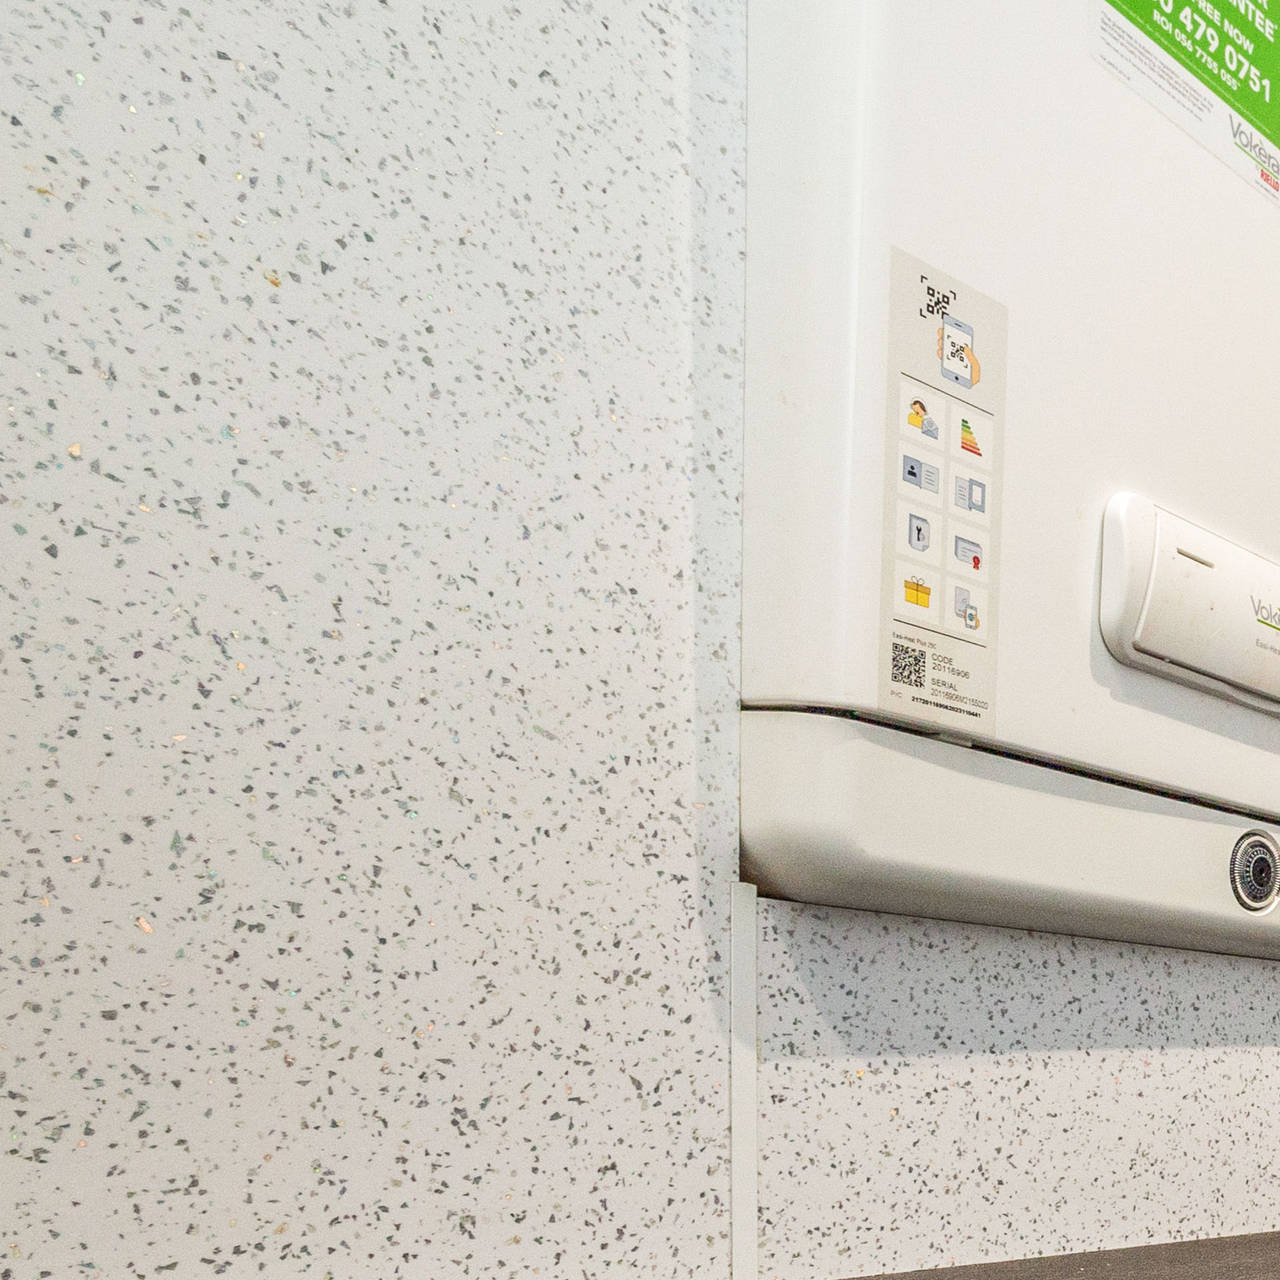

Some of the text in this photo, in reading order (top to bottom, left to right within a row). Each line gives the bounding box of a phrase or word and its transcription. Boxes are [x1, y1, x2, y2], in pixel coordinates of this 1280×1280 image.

[1153, 9, 1173, 35] ROI
[1190, 0, 1221, 27] REE
[1223, 19, 1254, 55] NOW
[1179, 6, 1219, 53] 479
[1224, 44, 1270, 103] 0751
